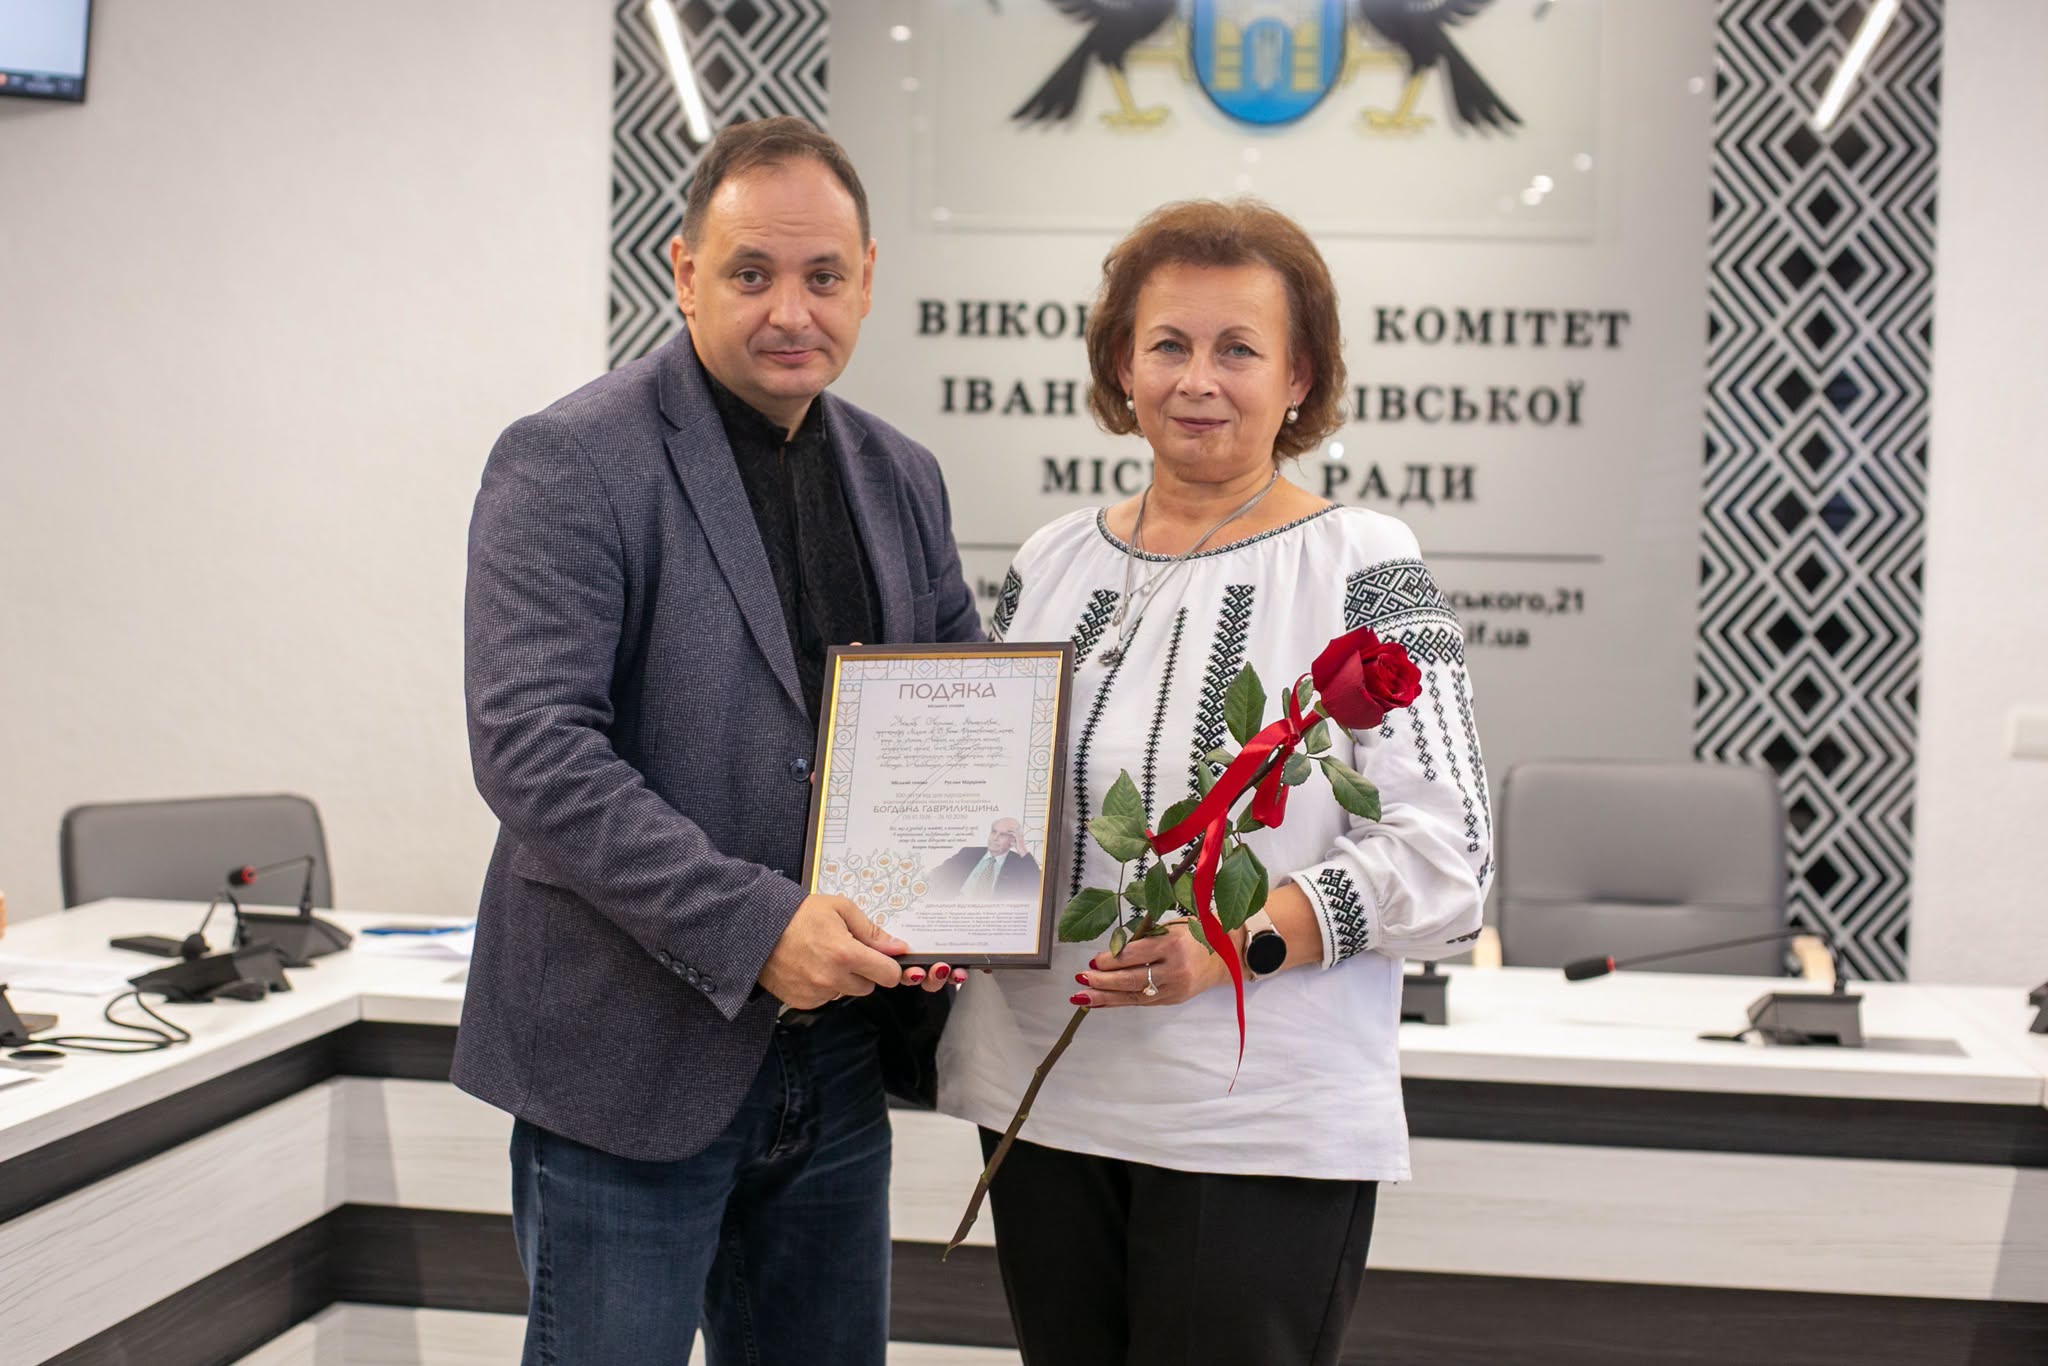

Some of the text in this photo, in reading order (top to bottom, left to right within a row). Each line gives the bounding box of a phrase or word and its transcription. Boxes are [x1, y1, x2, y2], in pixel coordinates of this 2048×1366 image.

[1375, 306, 1630, 348] КОМІТЕТ
[1353, 381, 1584, 426] ІВСЬКОЇ
[1322, 462, 1476, 506] РАДИ
[899, 683, 997, 701] ПОДЯКА
[874, 804, 1000, 814] БОГДАНА ГАВРИЛИШИНА
